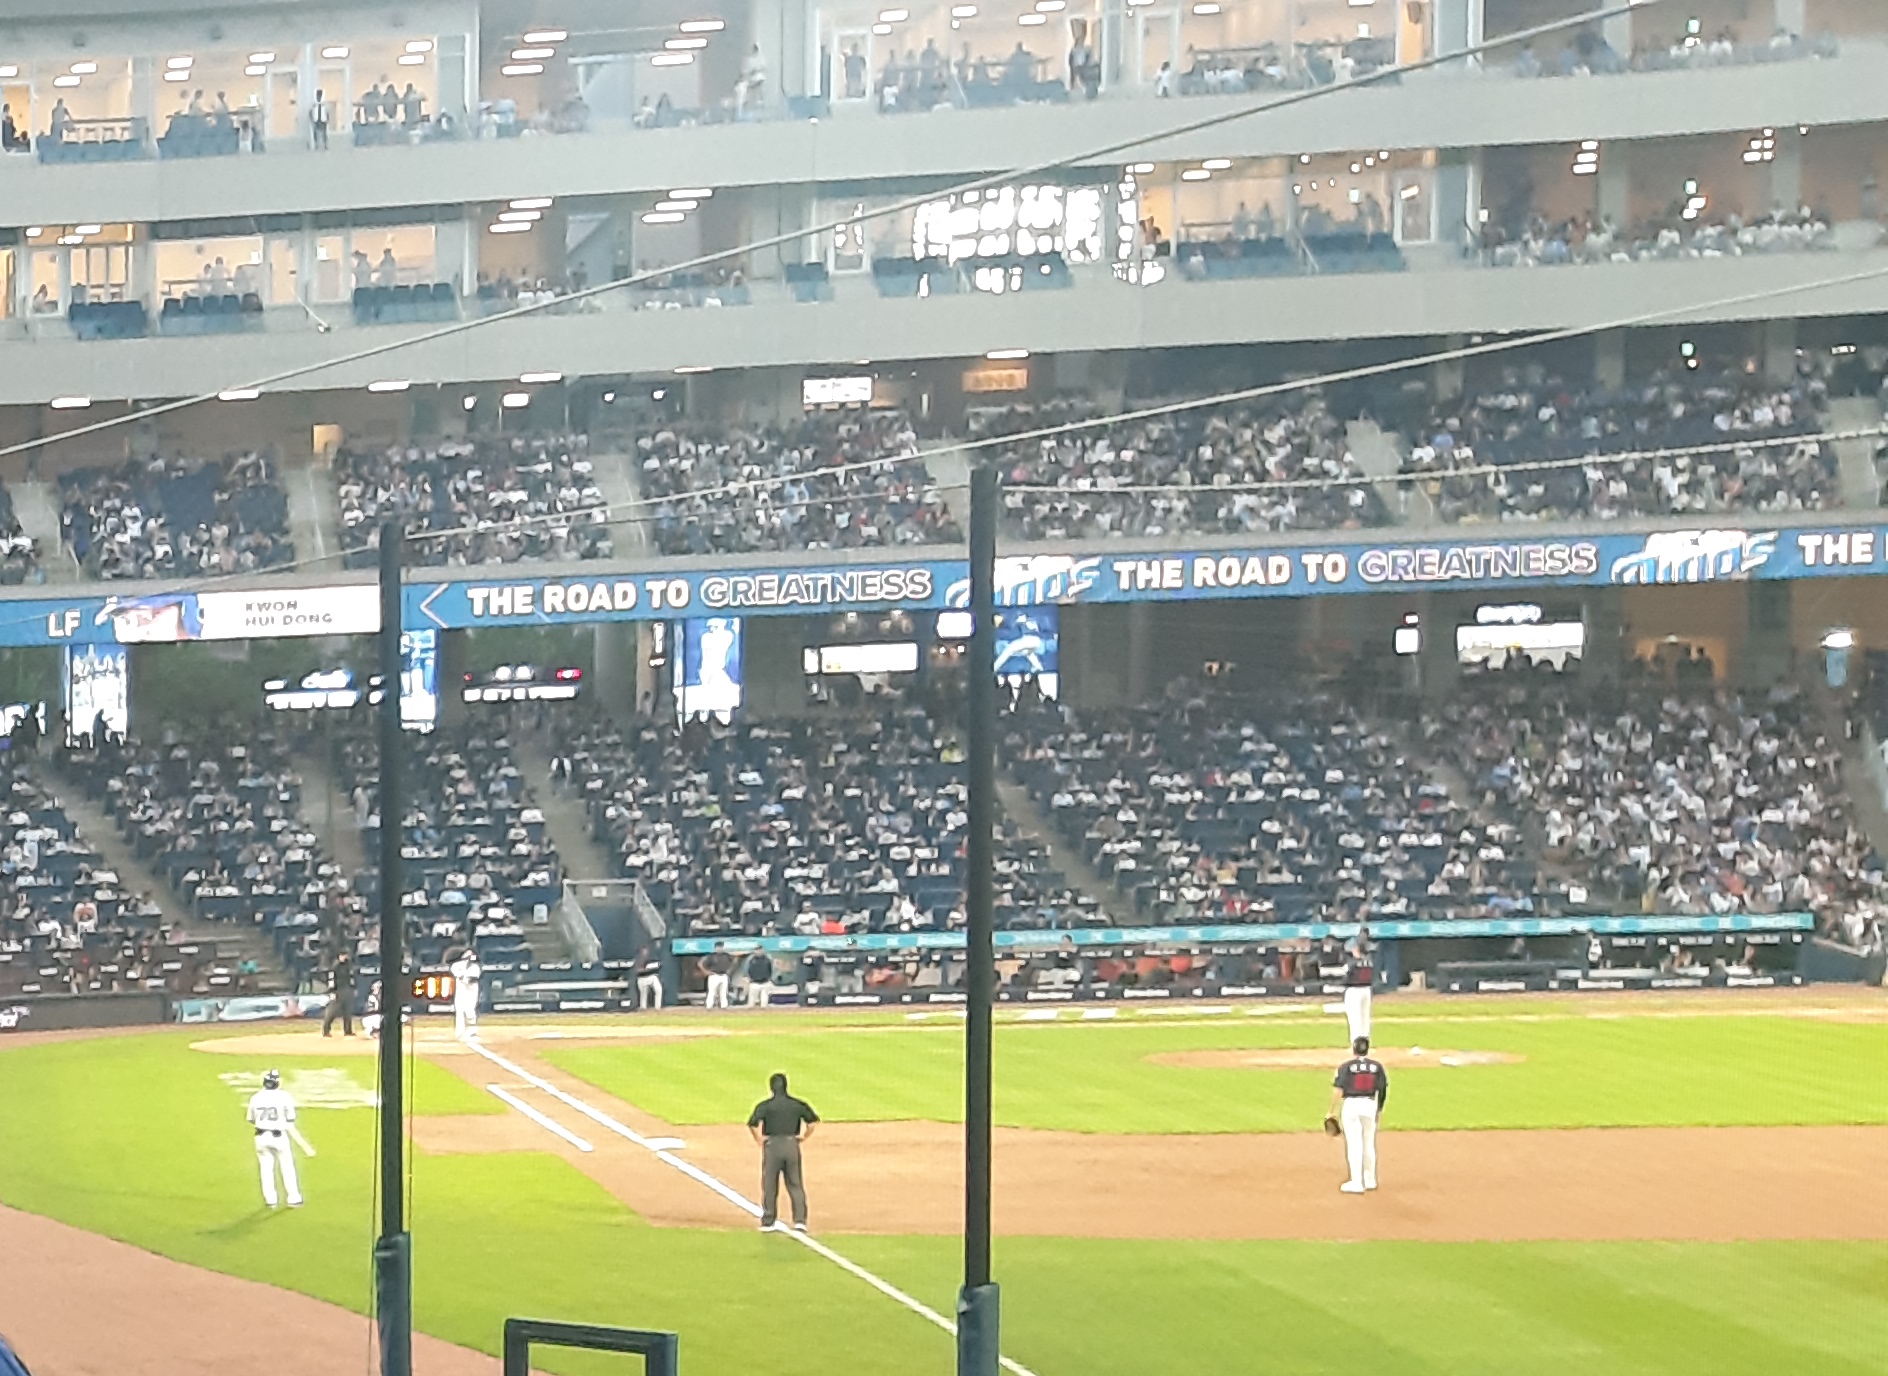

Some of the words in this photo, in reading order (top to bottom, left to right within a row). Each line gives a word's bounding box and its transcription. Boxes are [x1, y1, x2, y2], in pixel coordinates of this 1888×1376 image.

[1797, 532, 1875, 566] THE
[1113, 558, 1184, 591] THE
[1193, 554, 1291, 588] ROAD
[1300, 552, 1347, 583] TO
[1357, 541, 1600, 584] GREATNESS
[244, 600, 298, 612] KWON
[467, 585, 534, 618] THE
[543, 582, 637, 613] ROAD
[645, 579, 690, 610] TO
[699, 569, 932, 607] GREATNESS
[47, 610, 81, 638] LF
[244, 615, 277, 627] HUI
[282, 613, 333, 626] DONG
